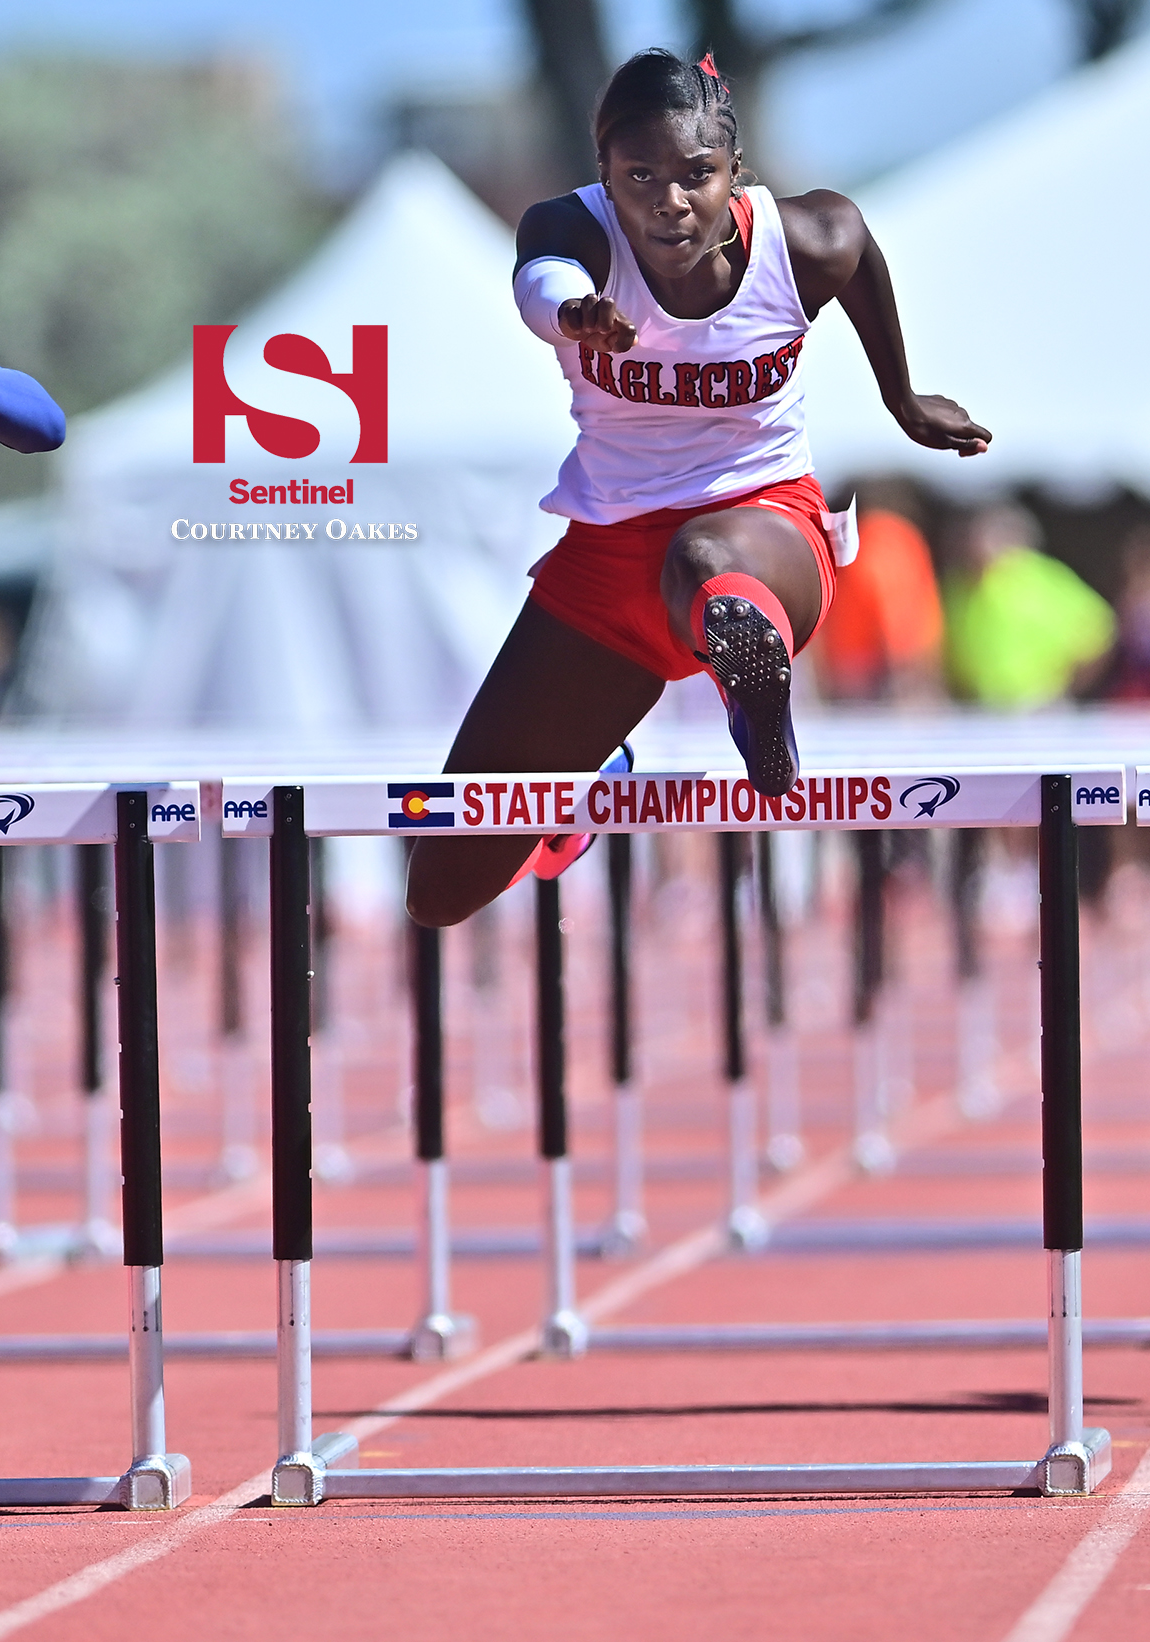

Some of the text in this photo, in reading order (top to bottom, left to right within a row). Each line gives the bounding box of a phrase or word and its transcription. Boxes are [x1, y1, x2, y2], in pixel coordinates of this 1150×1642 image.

[579, 334, 805, 408] EAGLECREST
[462, 775, 892, 826] STATE CHAMPIONSHIPS
